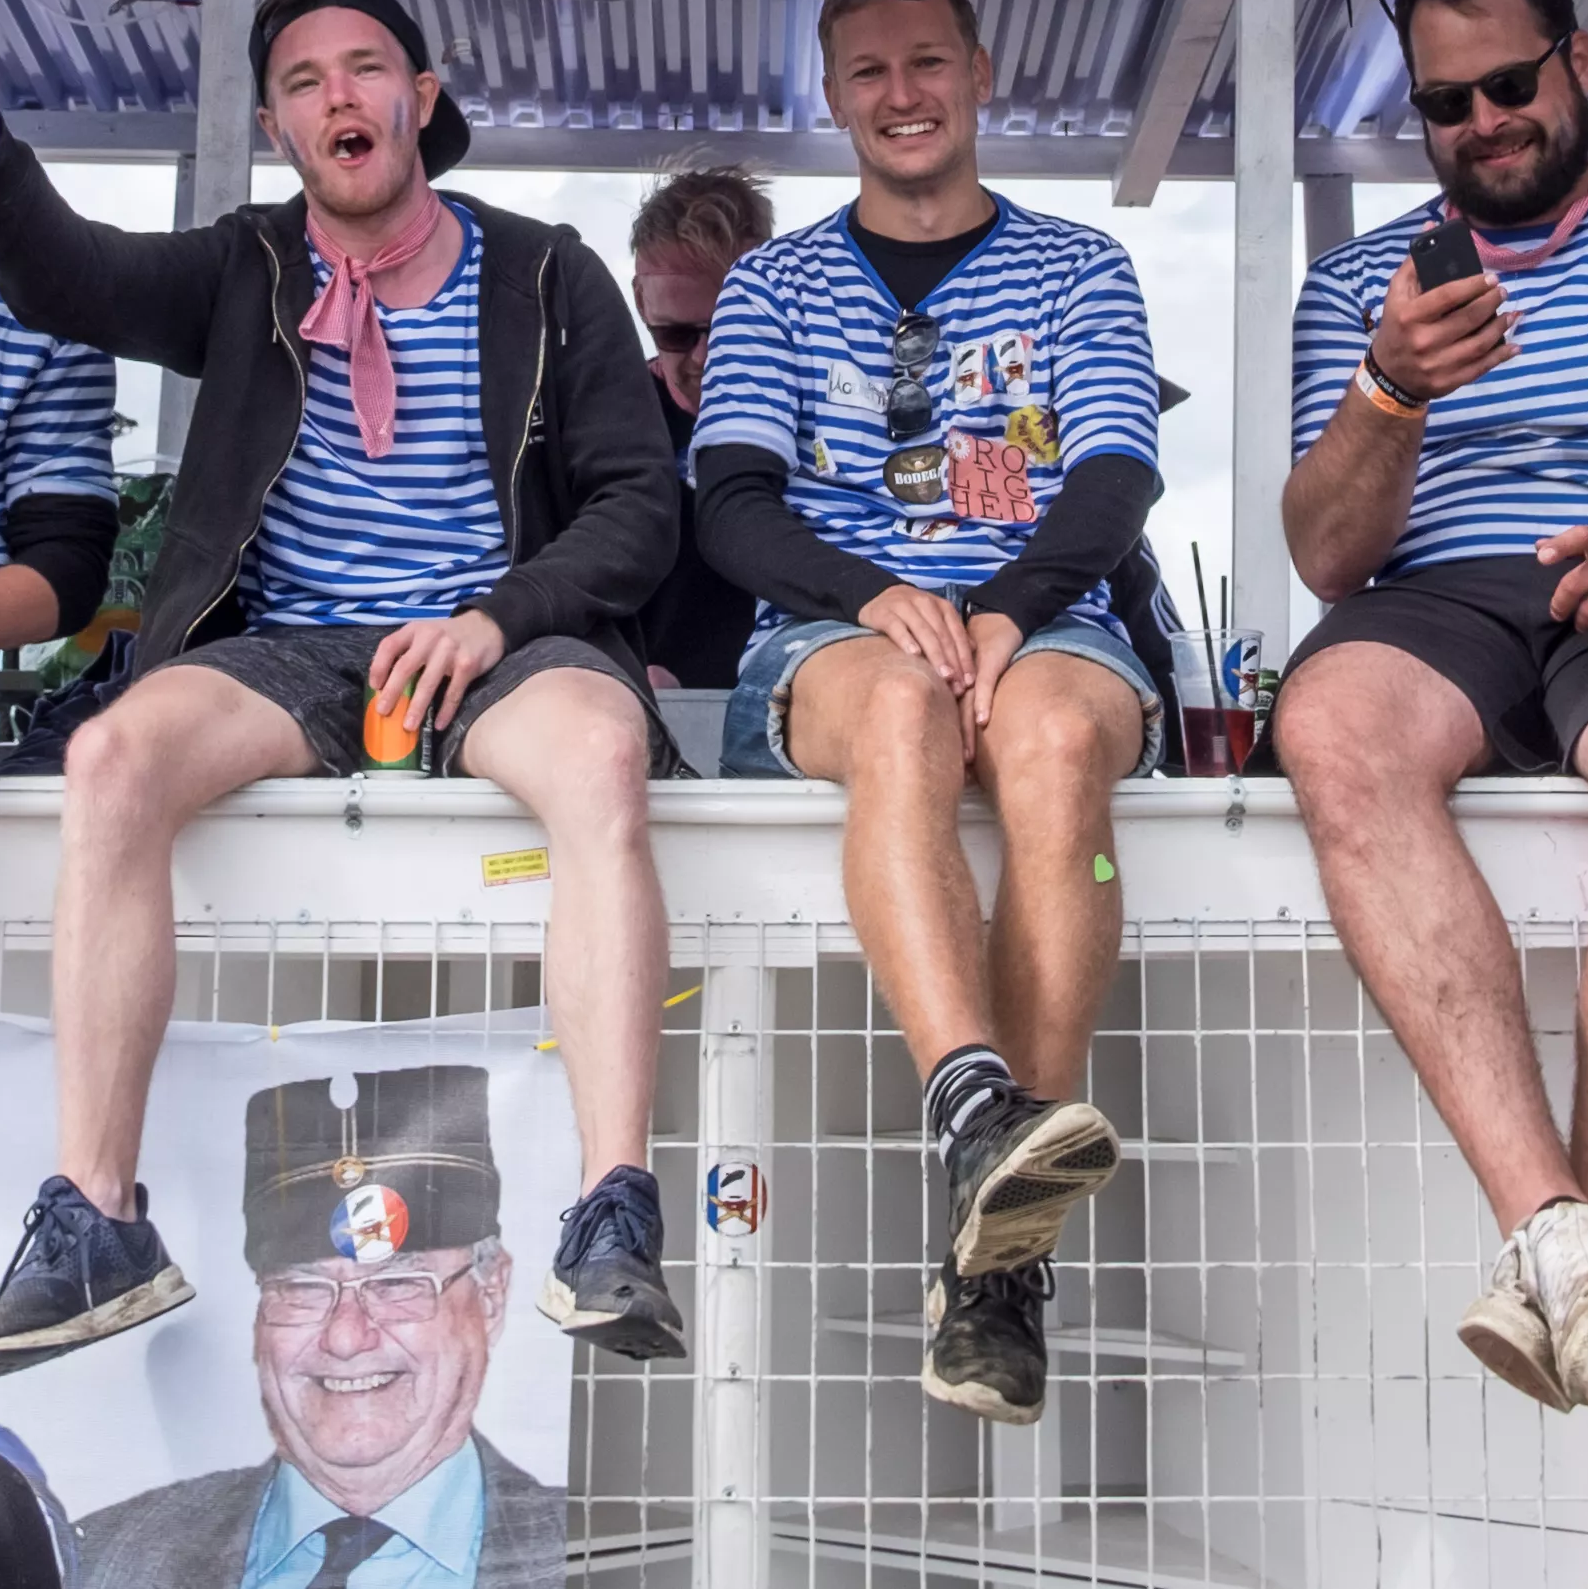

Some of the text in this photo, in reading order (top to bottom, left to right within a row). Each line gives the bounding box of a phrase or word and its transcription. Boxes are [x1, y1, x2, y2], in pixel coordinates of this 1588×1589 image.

[973, 436, 1027, 471] RO
[950, 458, 1029, 499] LIG
[952, 487, 1036, 523] HED
